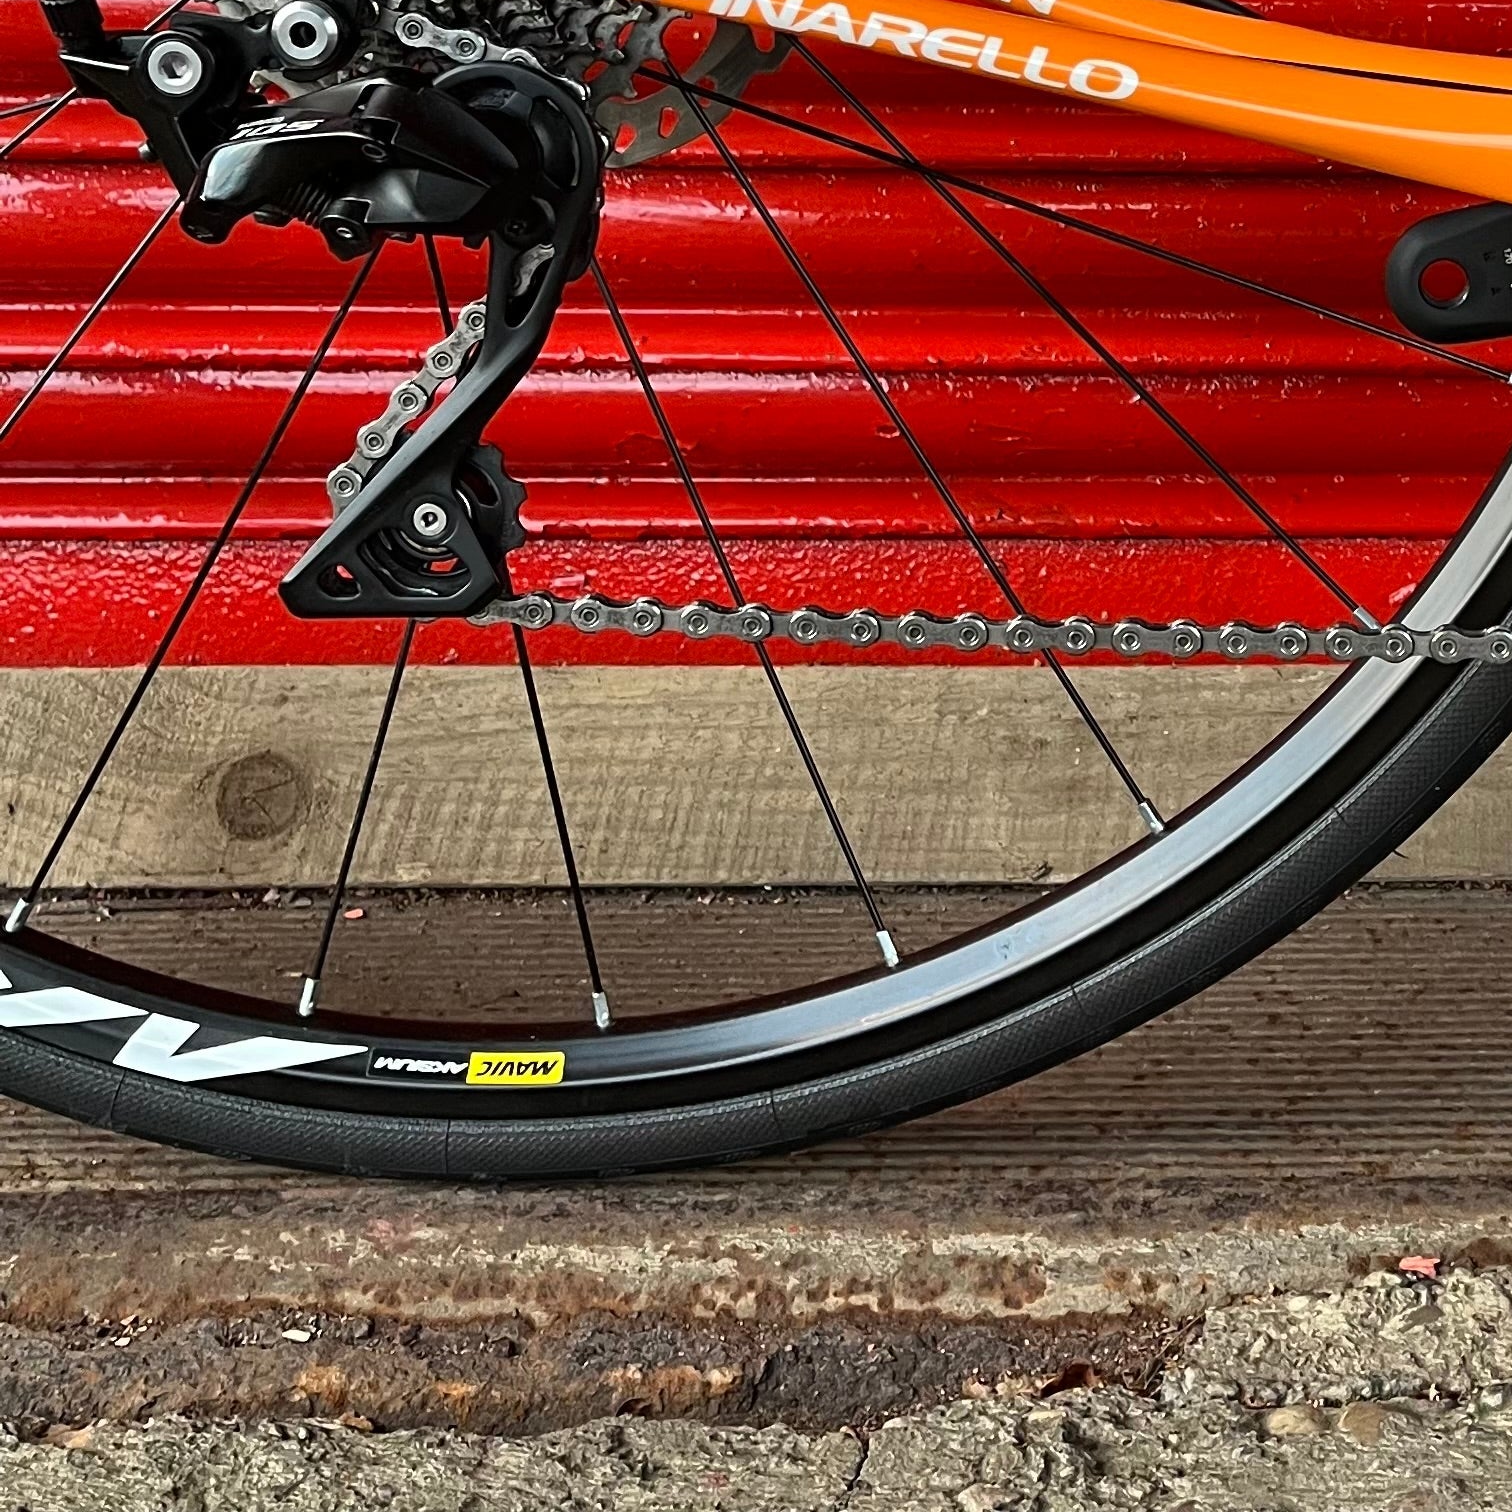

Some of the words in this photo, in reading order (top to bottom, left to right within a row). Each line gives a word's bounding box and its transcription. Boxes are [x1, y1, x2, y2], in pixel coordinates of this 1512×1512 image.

[229, 119, 326, 141] 105
[373, 1056, 469, 1075] AKSIUM
[475, 1059, 560, 1077] MAVIC
